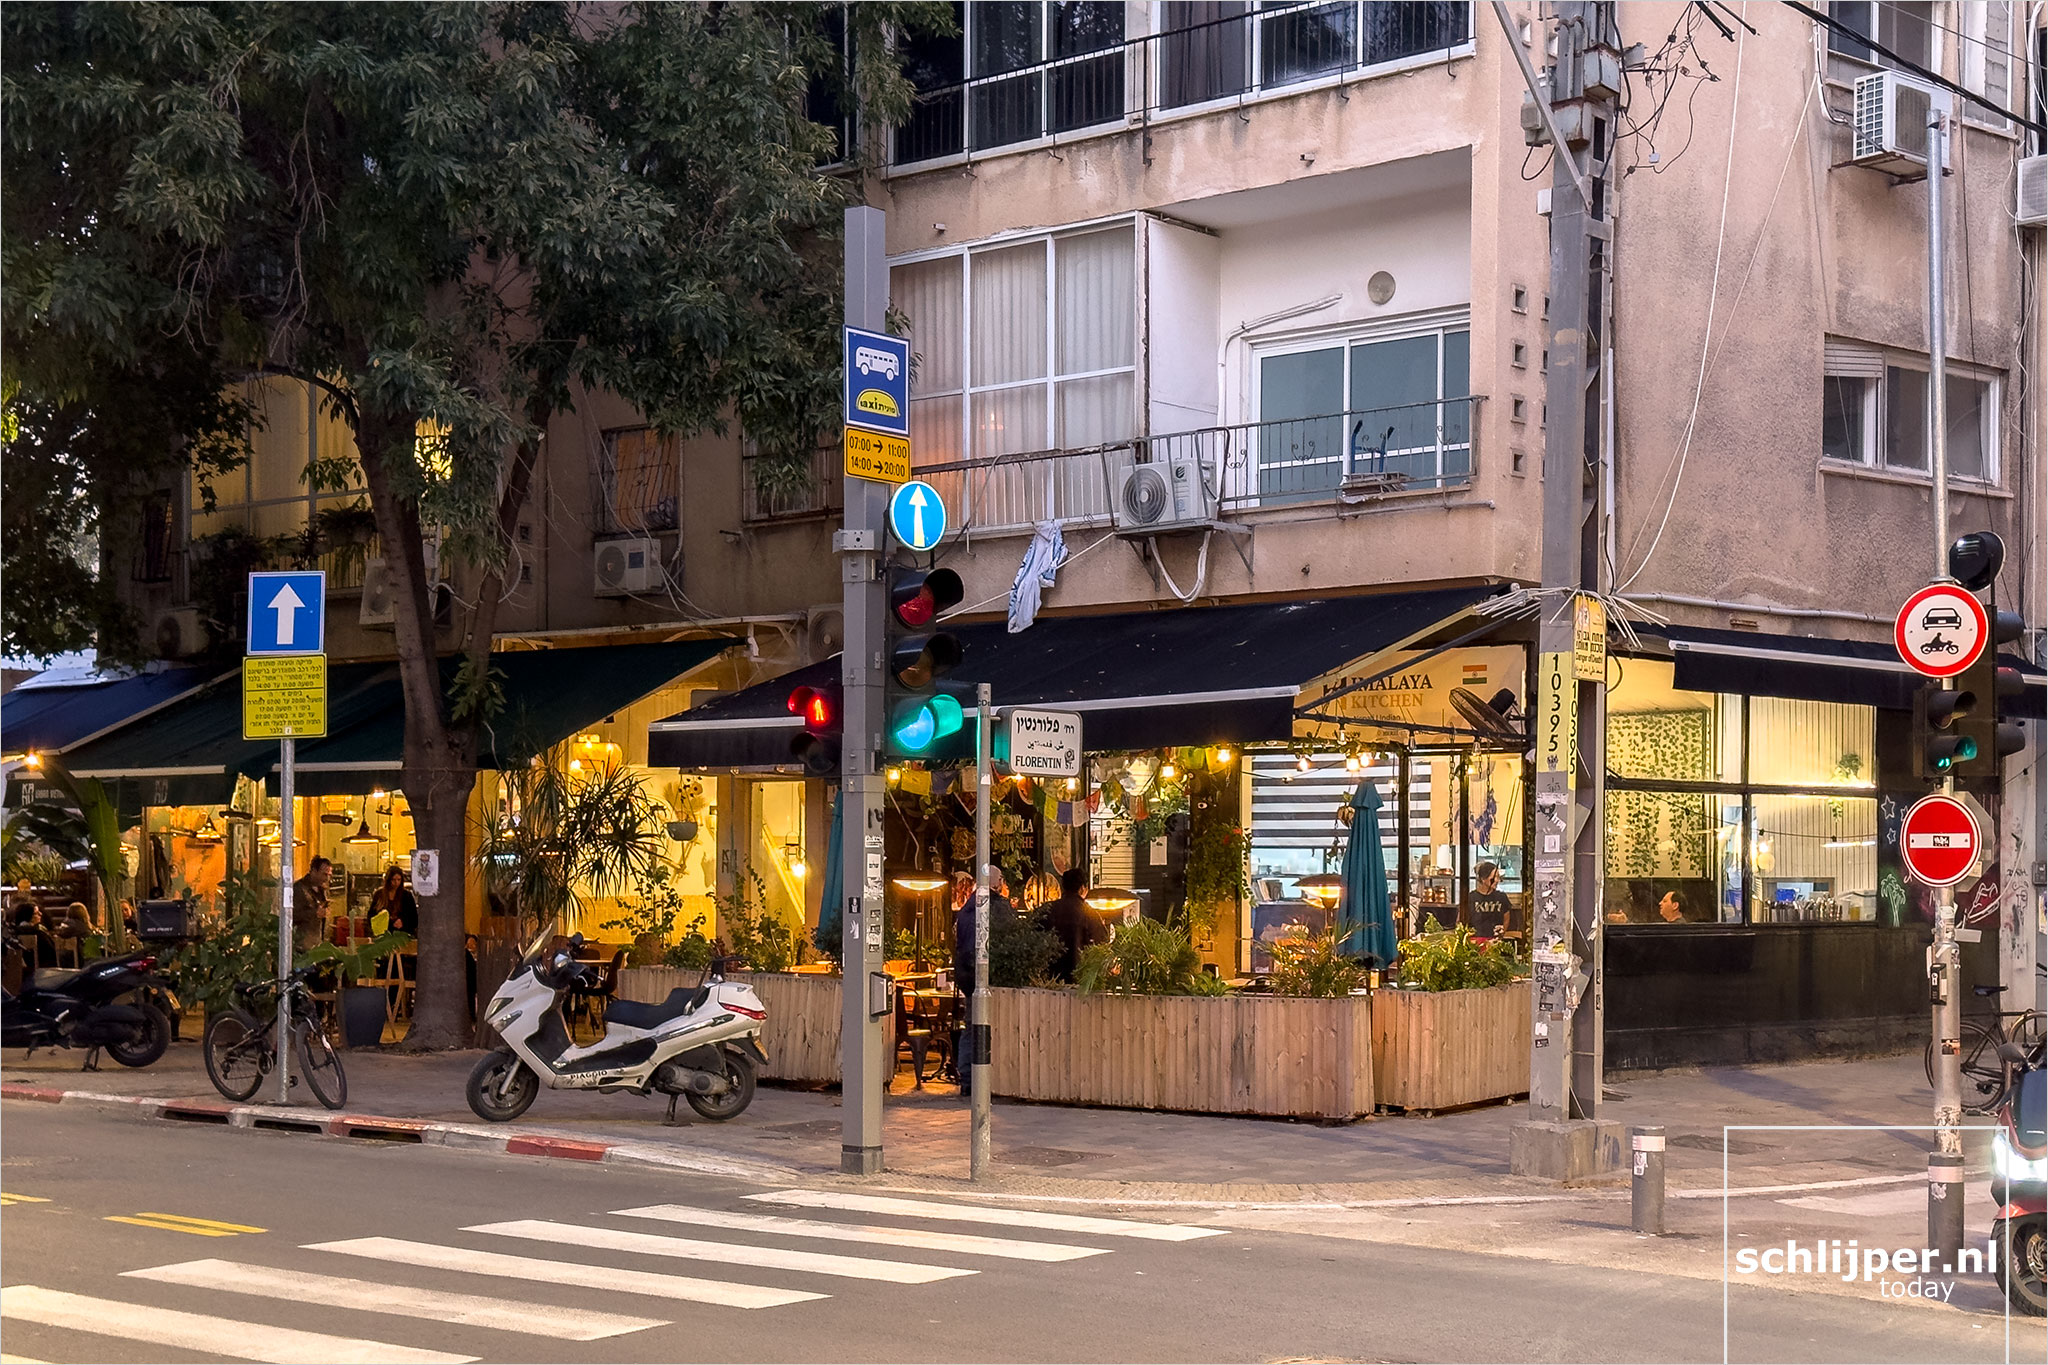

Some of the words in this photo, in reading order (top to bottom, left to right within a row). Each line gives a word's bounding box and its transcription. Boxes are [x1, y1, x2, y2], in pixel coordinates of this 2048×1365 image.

[860, 397, 878, 410] taxi
[850, 436, 870, 451] 07:00
[888, 444, 906, 458] 11:00
[851, 456, 872, 470] 14:00
[884, 462, 905, 477] 20:00
[1351, 674, 1433, 691] MALAYA
[1352, 693, 1424, 709] KITCHEN
[1548, 654, 1561, 752] 10395
[1016, 716, 1060, 734] פלורנטין
[1015, 755, 1062, 769] FLORENTIN
[1065, 761, 1074, 770] ST.
[570, 1070, 608, 1080] PIAGGIO
